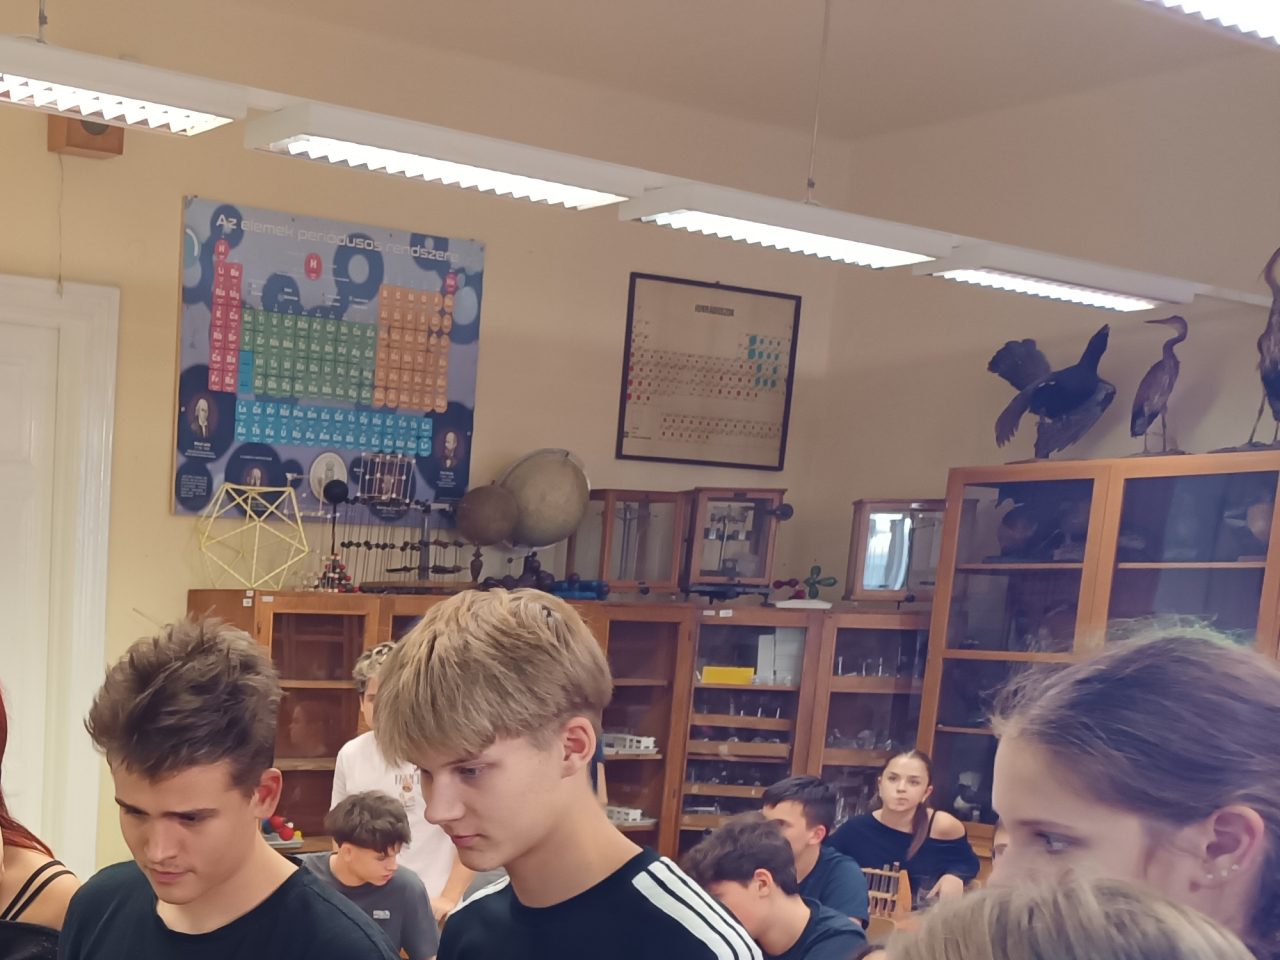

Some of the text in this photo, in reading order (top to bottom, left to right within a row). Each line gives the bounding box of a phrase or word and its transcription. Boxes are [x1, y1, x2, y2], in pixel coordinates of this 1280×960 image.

[216, 214, 237, 229] Az
[241, 219, 295, 238] elemek
[386, 243, 459, 262] rendszere
